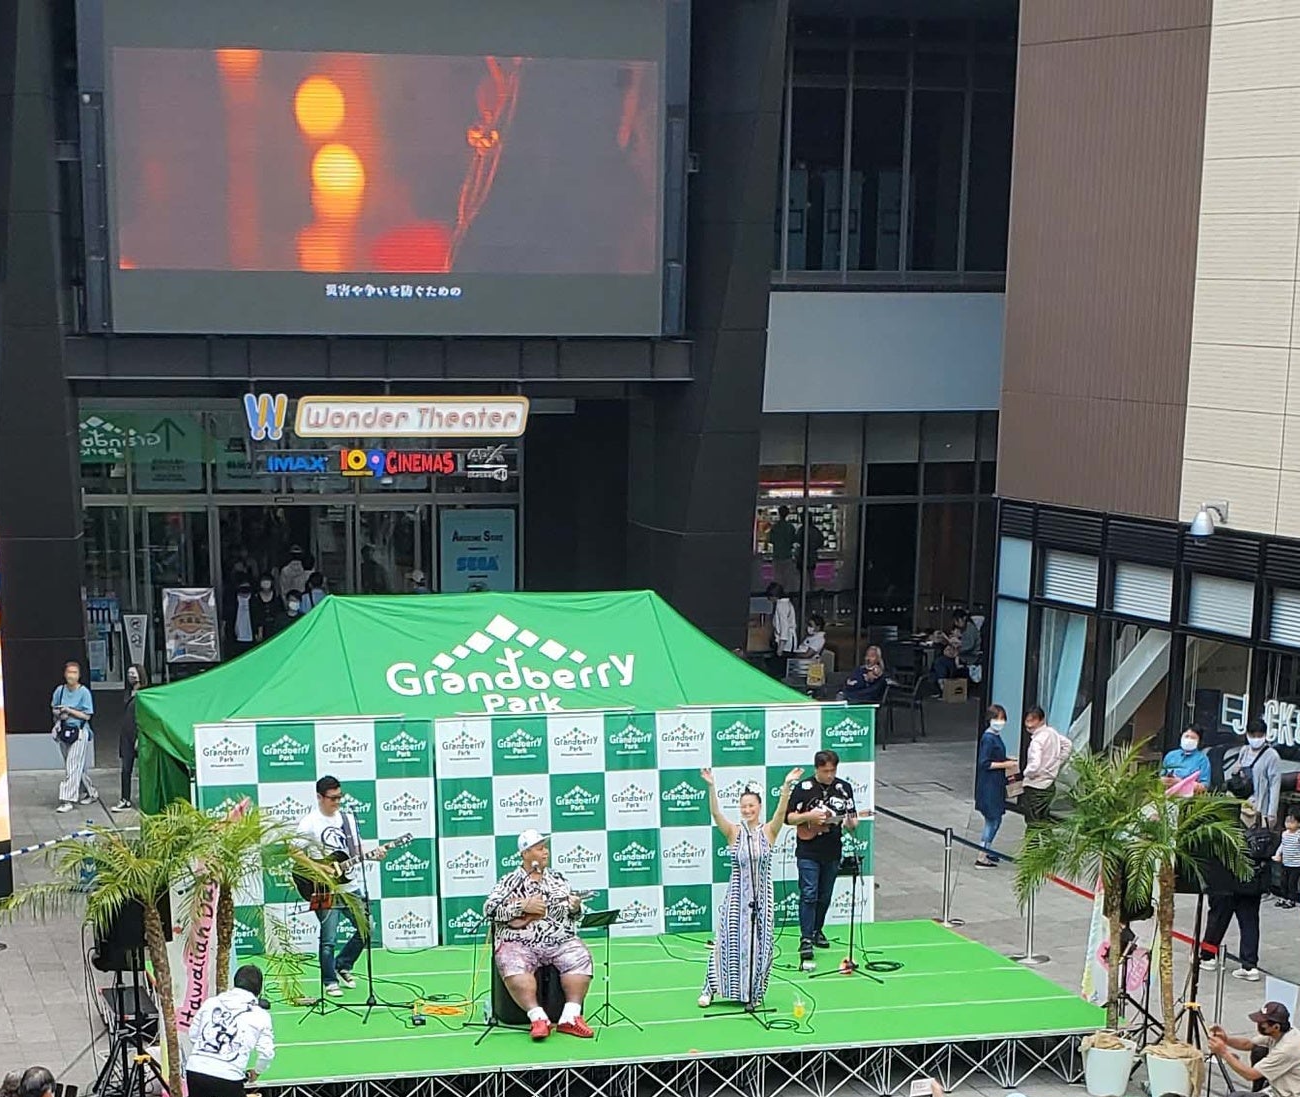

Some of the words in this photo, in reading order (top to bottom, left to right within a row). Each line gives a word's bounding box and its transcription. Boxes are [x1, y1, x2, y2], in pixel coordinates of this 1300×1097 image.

[306, 406, 409, 429] Wonder
[418, 406, 517, 429] Theater
[267, 455, 327, 472] IMAX
[341, 448, 385, 479] 109
[386, 451, 455, 474] CINEMAS
[386, 648, 635, 696] Grandberry
[482, 692, 565, 713] Park
